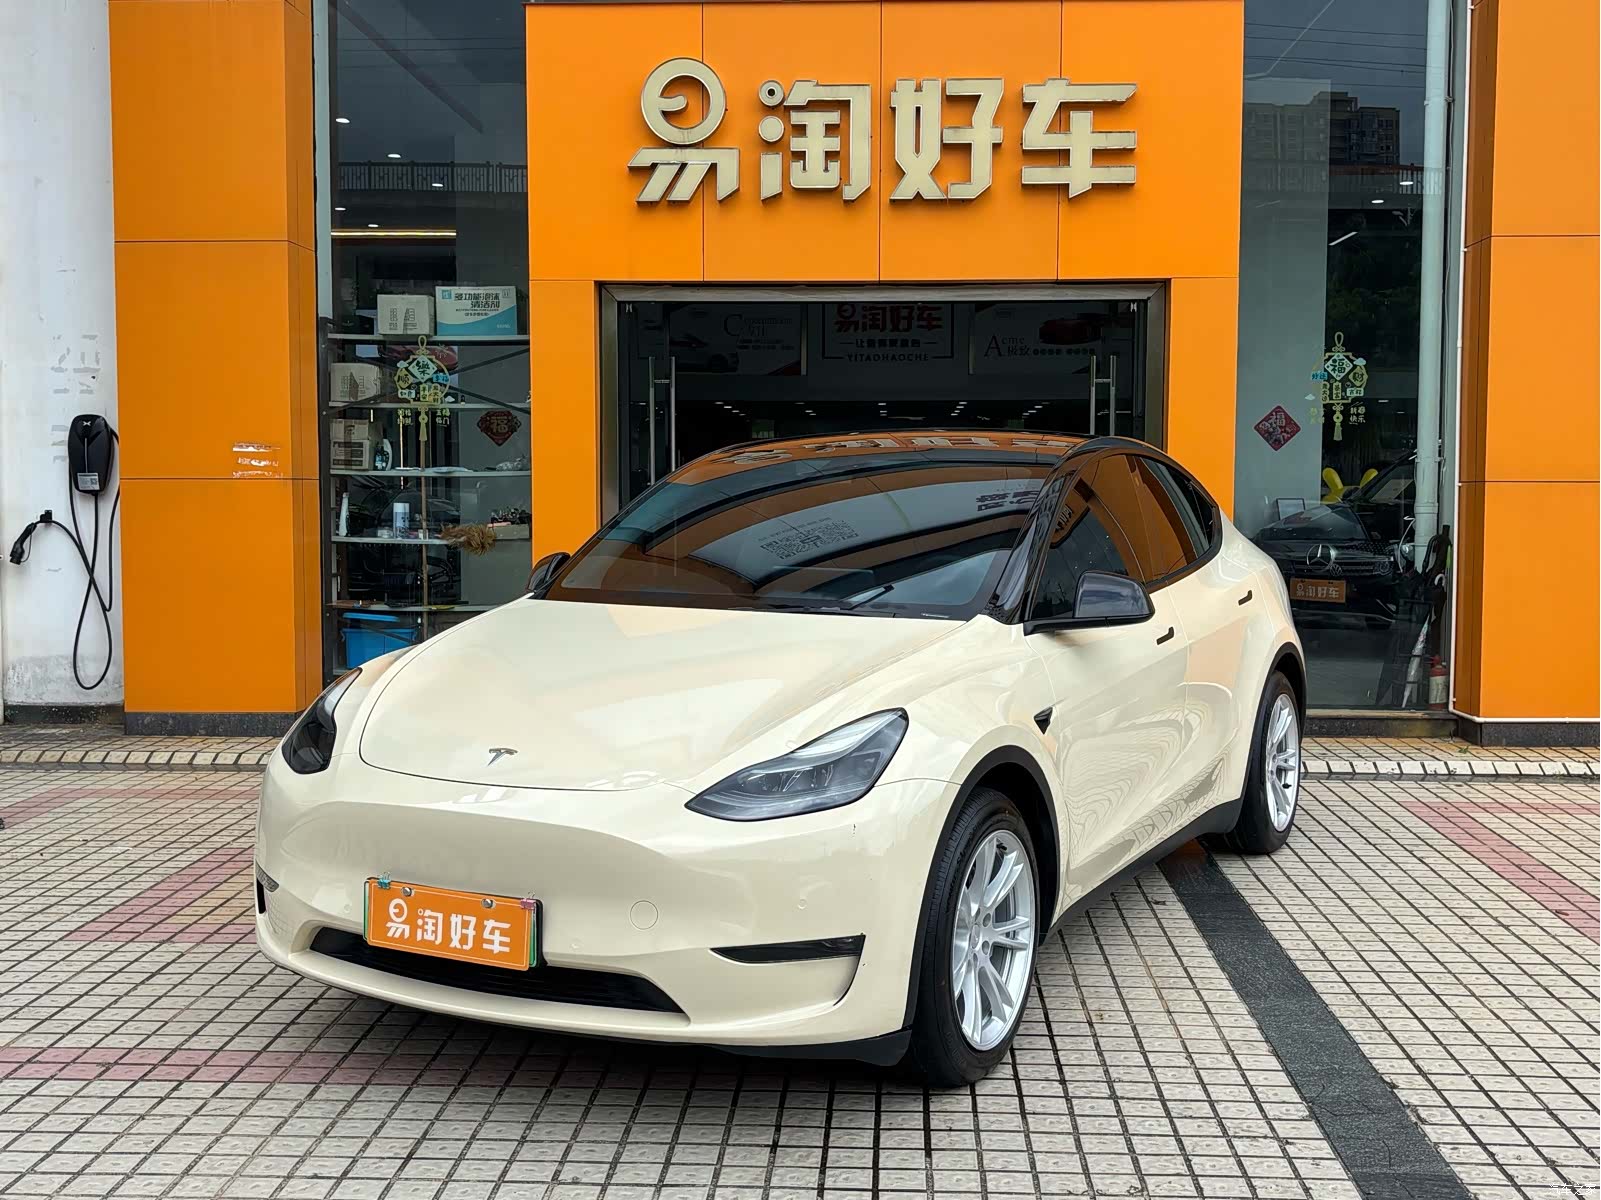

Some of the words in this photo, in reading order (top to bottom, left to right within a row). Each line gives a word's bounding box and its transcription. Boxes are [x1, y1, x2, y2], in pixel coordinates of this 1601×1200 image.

[627, 57, 1138, 203] 易淘好车
[834, 303, 944, 333] 易淘好车
[984, 335, 1025, 357] Acme
[847, 353, 929, 363] YITAOHAOCHE
[1330, 358, 1347, 374] 福
[490, 415, 508, 433] 福
[1296, 583, 1339, 598] 易淘好车
[385, 898, 511, 954] 易淘好车
